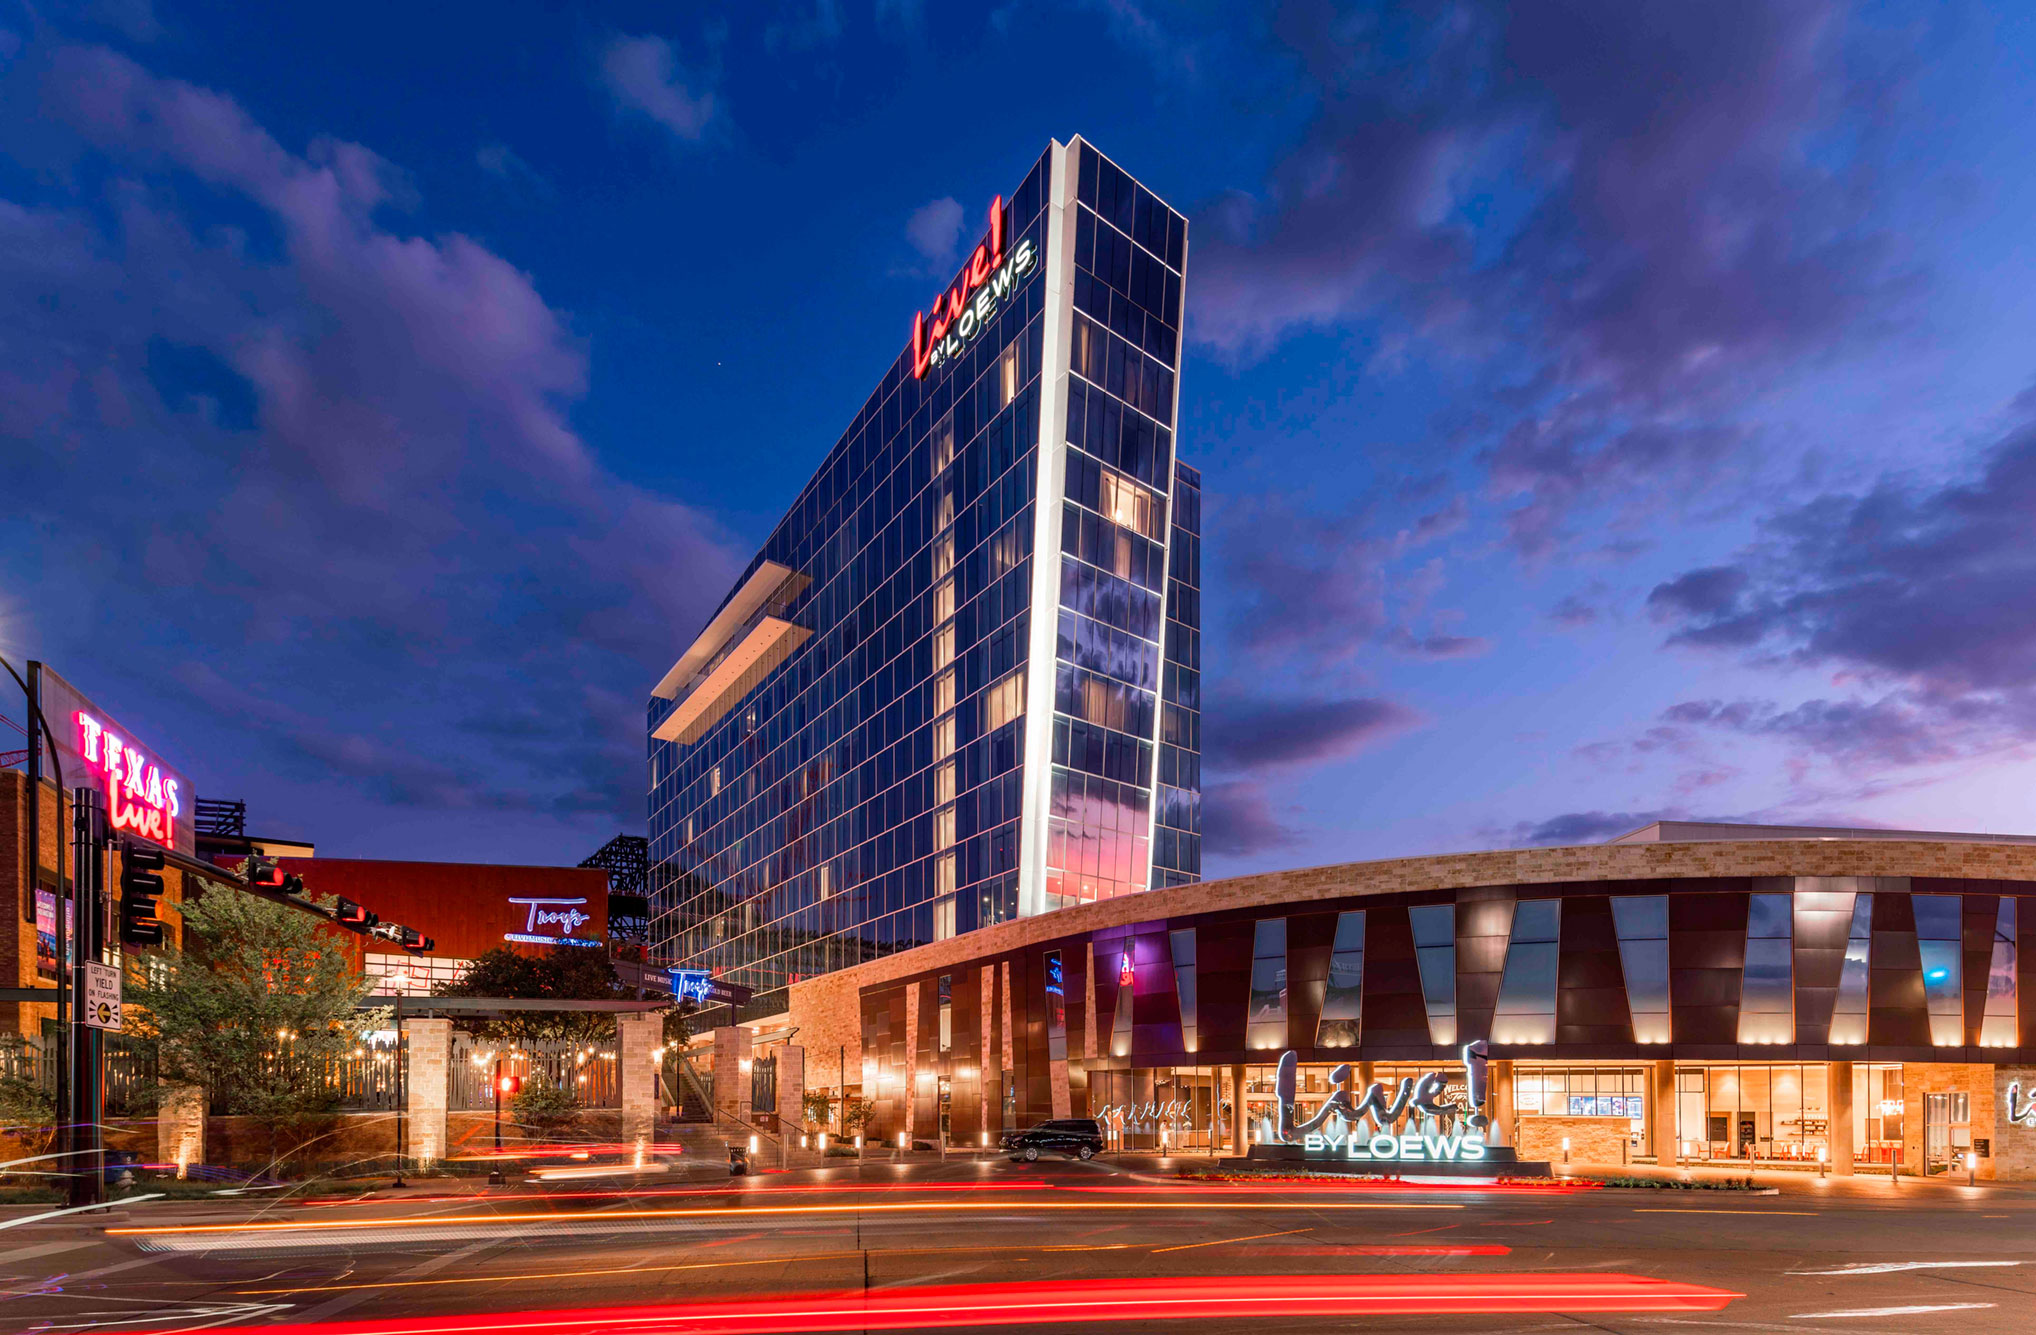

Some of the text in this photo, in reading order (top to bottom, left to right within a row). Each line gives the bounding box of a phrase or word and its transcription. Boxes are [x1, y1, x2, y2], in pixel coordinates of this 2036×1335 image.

[930, 239, 1031, 366] BY LOEWS
[77, 711, 179, 817] TEXAS
[90, 966, 116, 978] LEFT TURN
[644, 973, 657, 982] LIVE
[95, 977, 113, 990] YIELD
[89, 988, 119, 1001] ON FLASHING
[1305, 1134, 1485, 1160] BY LOEWS
